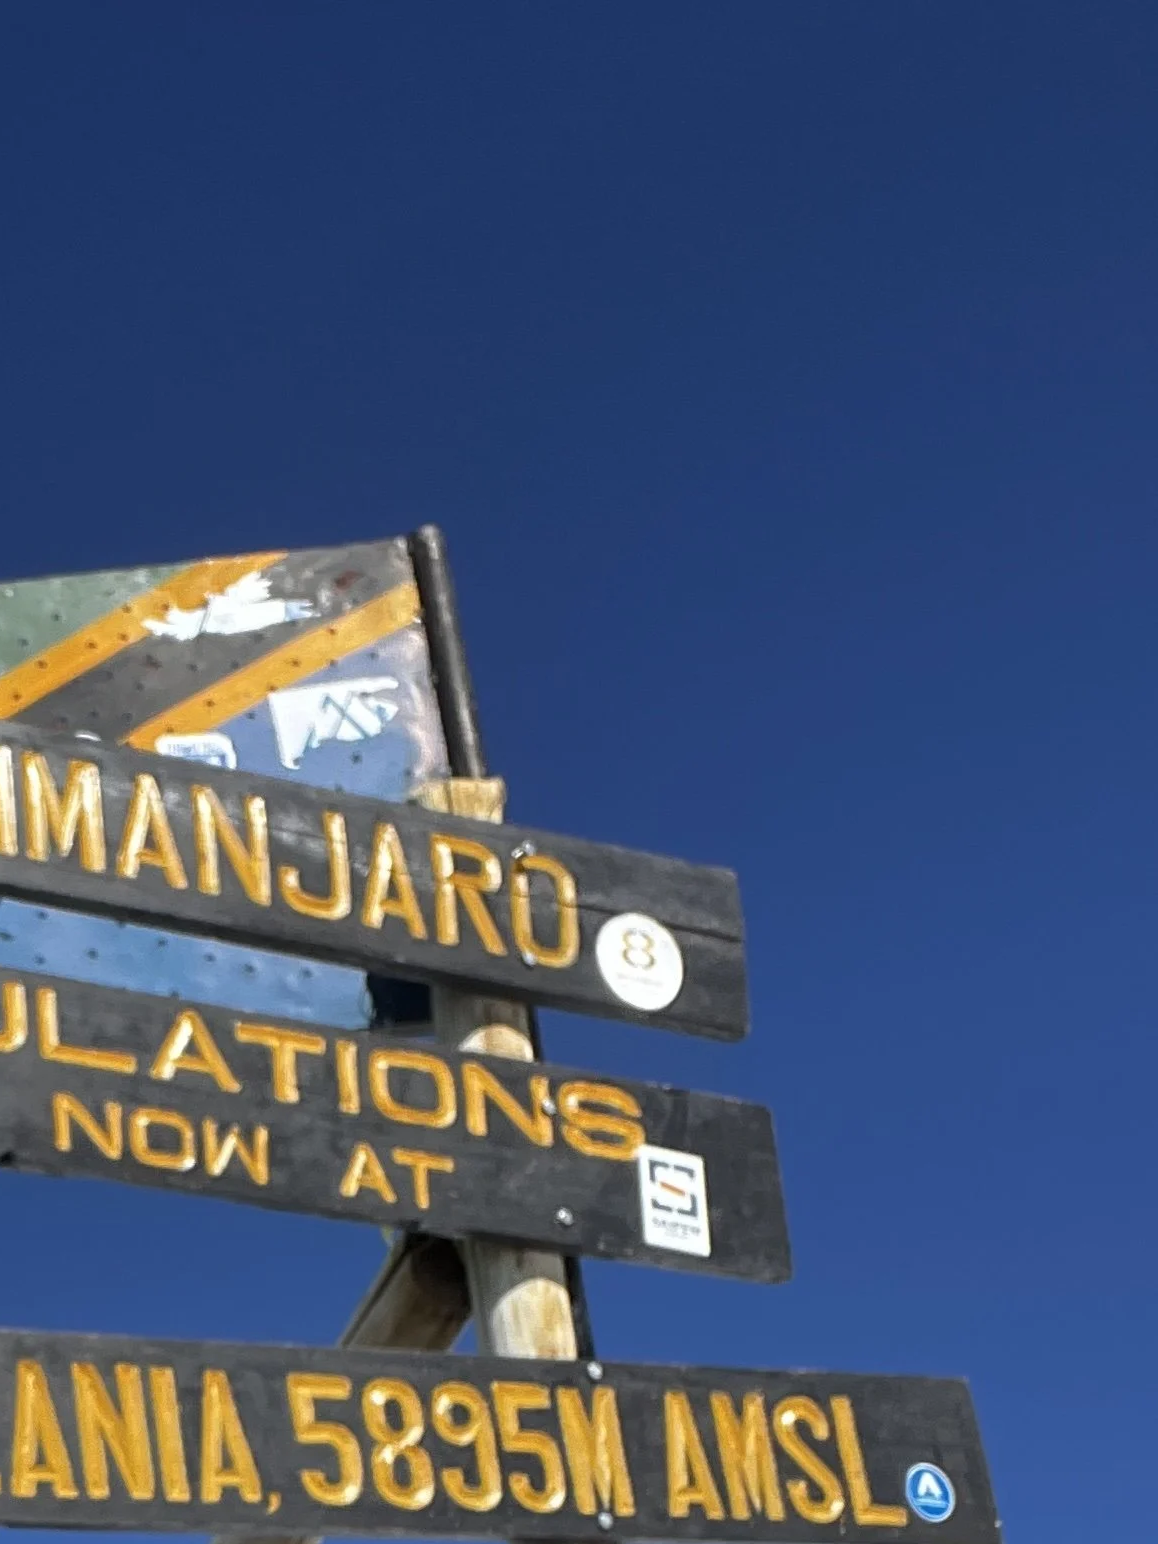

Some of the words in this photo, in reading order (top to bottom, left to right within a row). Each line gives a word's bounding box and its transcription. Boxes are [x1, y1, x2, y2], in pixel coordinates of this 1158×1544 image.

[50, 1090, 272, 1187] NOW
[340, 1140, 457, 1211] AT
[285, 1370, 638, 1519] 5895M
[662, 1390, 911, 1529] AMSL
